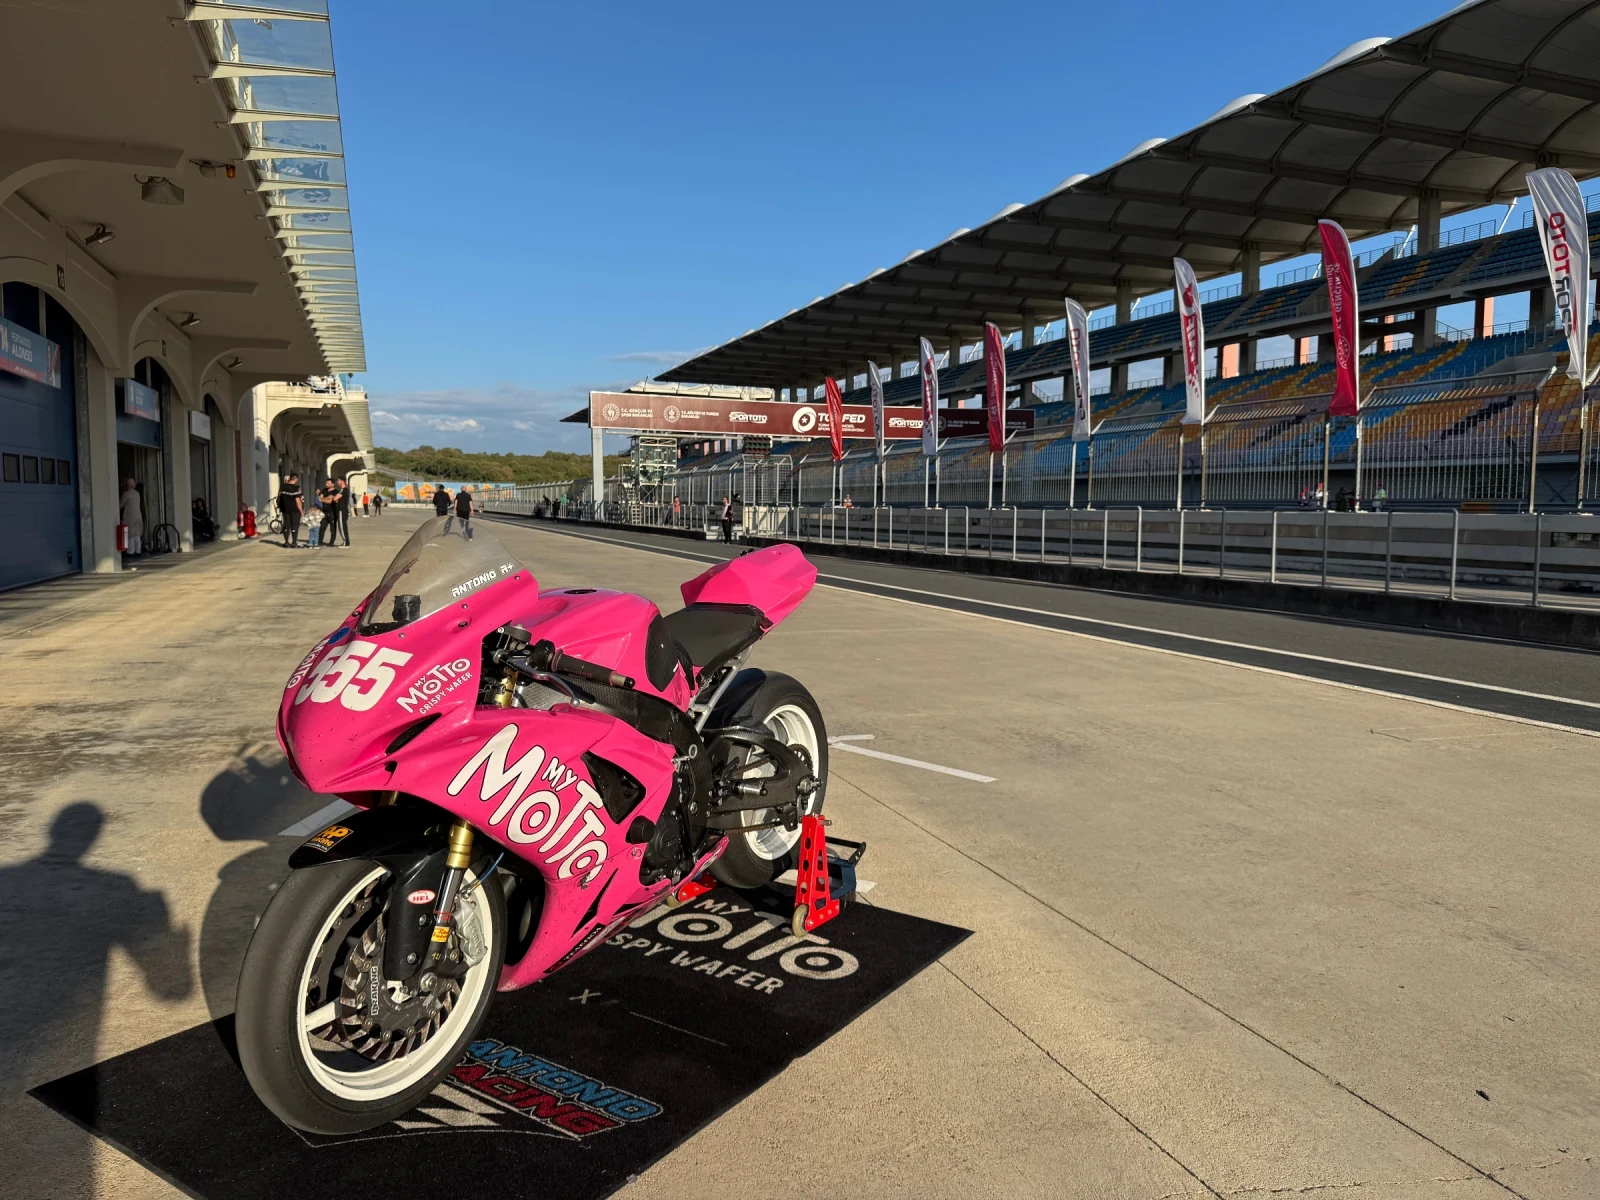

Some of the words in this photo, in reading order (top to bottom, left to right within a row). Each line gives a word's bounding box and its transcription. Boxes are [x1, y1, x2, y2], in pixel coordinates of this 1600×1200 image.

[12, 344, 32, 362] ALONSO
[818, 413, 866, 424] TOFED
[451, 570, 497, 598] ANTONIO
[295, 640, 414, 712] 555
[396, 658, 471, 713] MOTTO
[414, 676, 427, 689] MY
[419, 691, 446, 715] CRISPY
[445, 672, 473, 693] WAFER
[541, 757, 579, 792] MY
[447, 723, 609, 884] MOTTO
[694, 898, 750, 915] MY
[605, 933, 674, 957] SPY
[670, 950, 785, 995] WAFER
[371, 966, 379, 1016] BRAKING
[450, 1065, 618, 1135] ACING
[468, 1039, 662, 1121] ANTONIO
